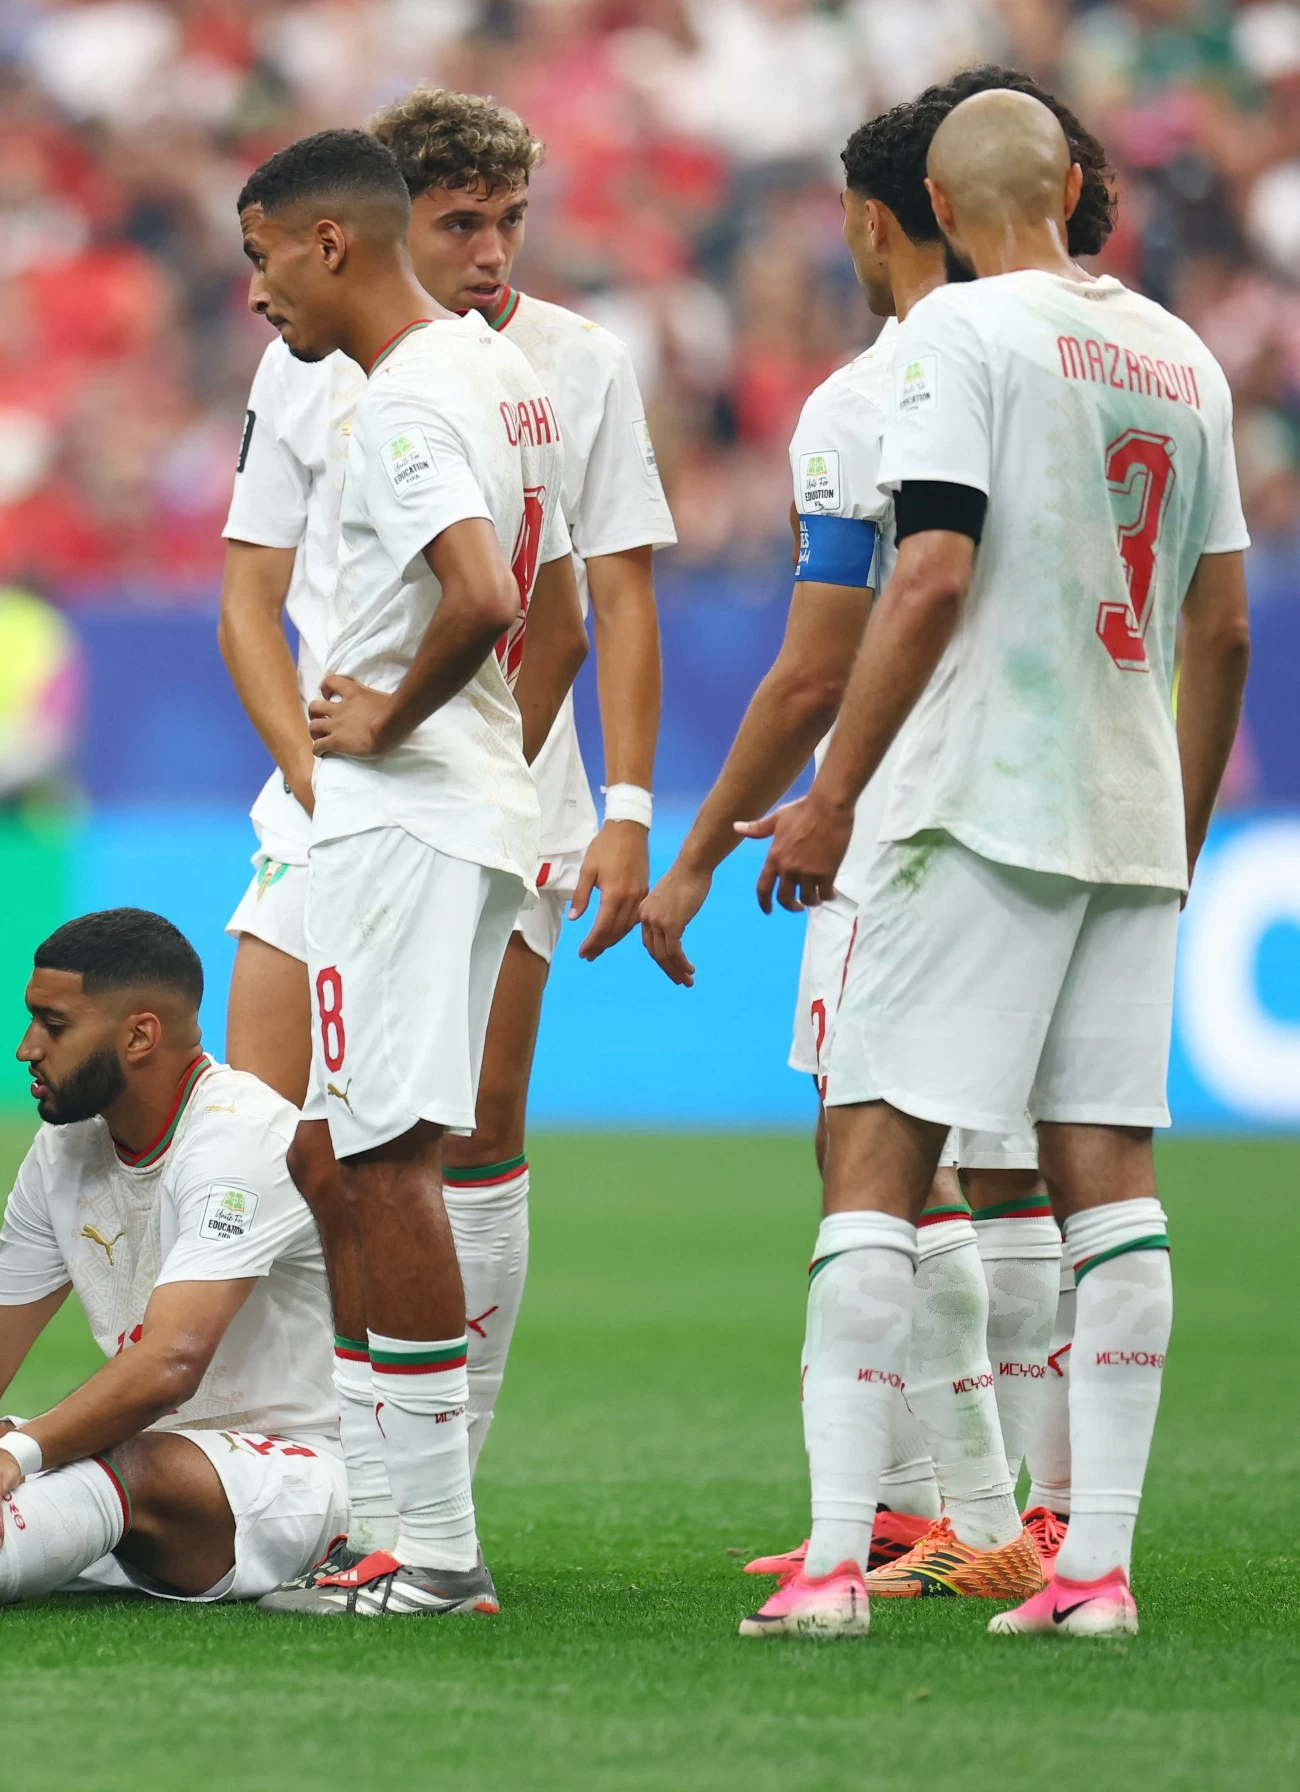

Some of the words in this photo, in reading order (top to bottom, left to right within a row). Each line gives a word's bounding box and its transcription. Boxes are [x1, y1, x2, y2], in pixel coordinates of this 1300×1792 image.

[1056, 335, 1201, 410] MAZRAOUI
[394, 461, 429, 485] EDUCATION
[1096, 428, 1177, 673] 3
[315, 965, 346, 1073] 8
[208, 1219, 244, 1236] EDUCATION
